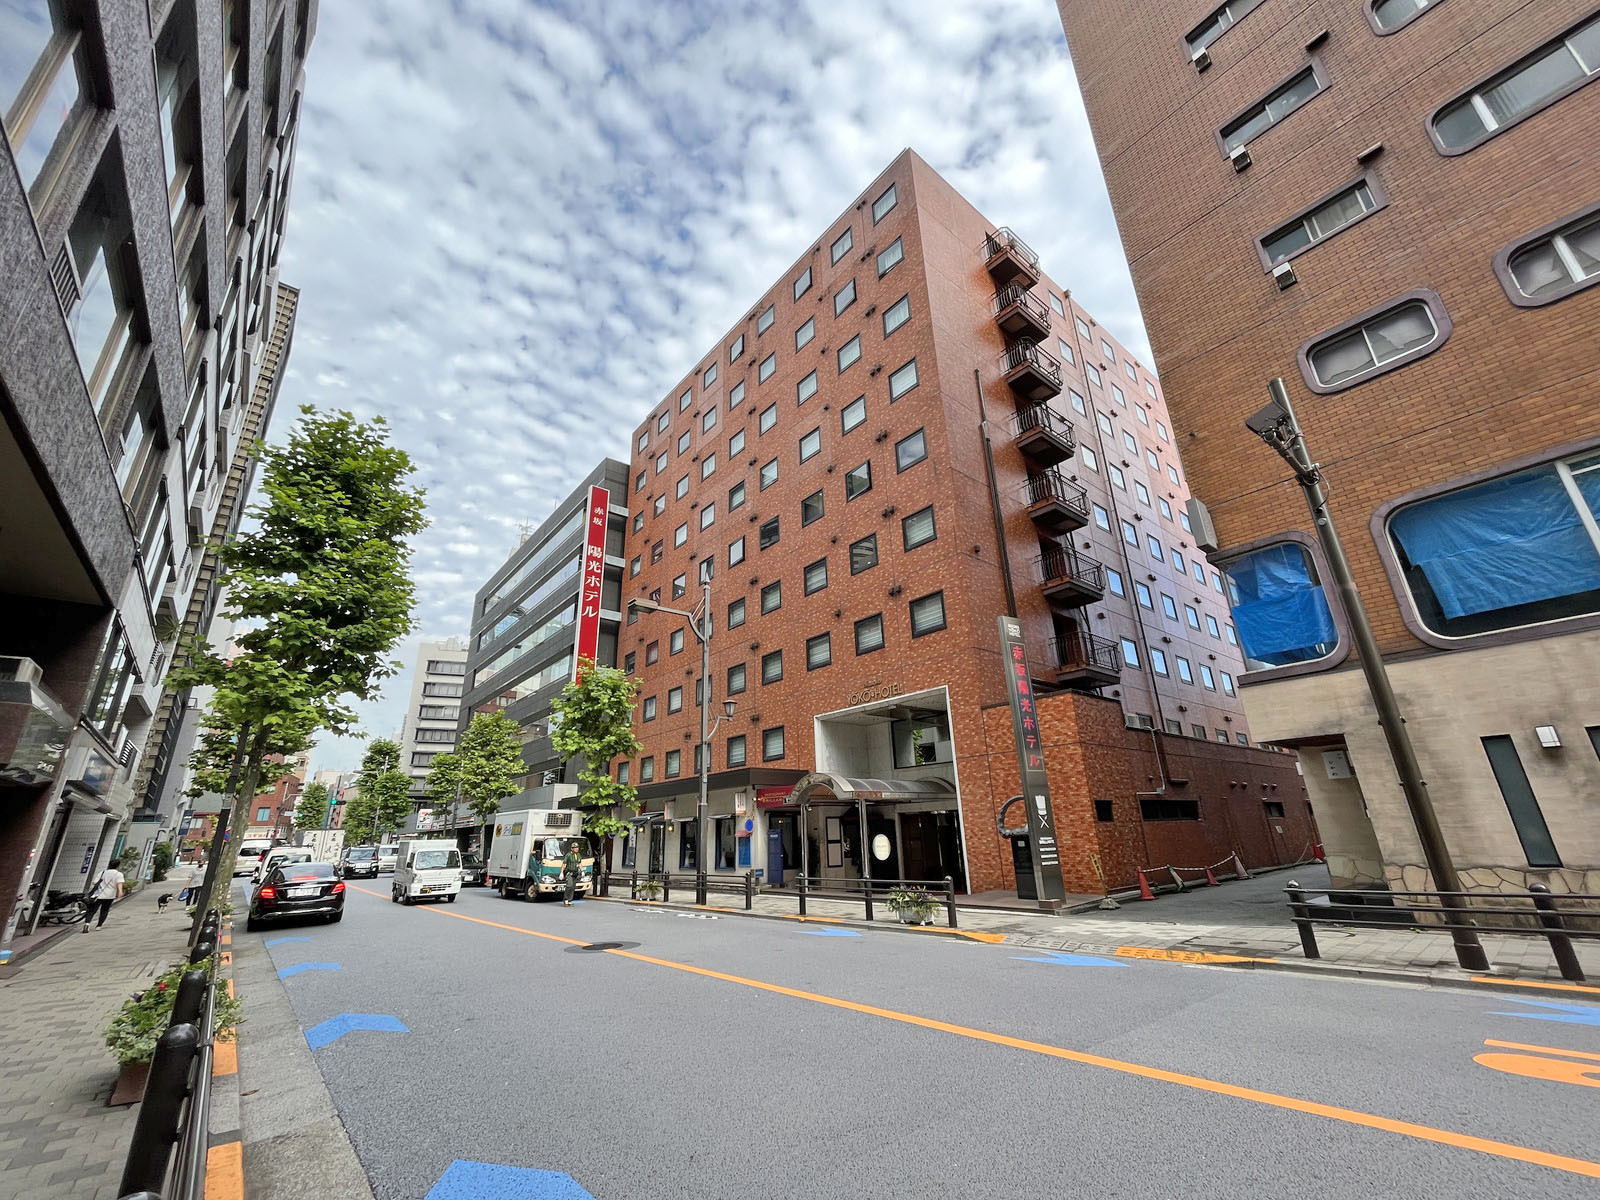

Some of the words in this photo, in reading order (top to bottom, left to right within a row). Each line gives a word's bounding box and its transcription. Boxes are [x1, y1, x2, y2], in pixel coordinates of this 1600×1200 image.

[593, 506, 604, 526] 赤坂
[582, 545, 602, 618] 陽光ホテル
[874, 683, 904, 698] HOTEL
